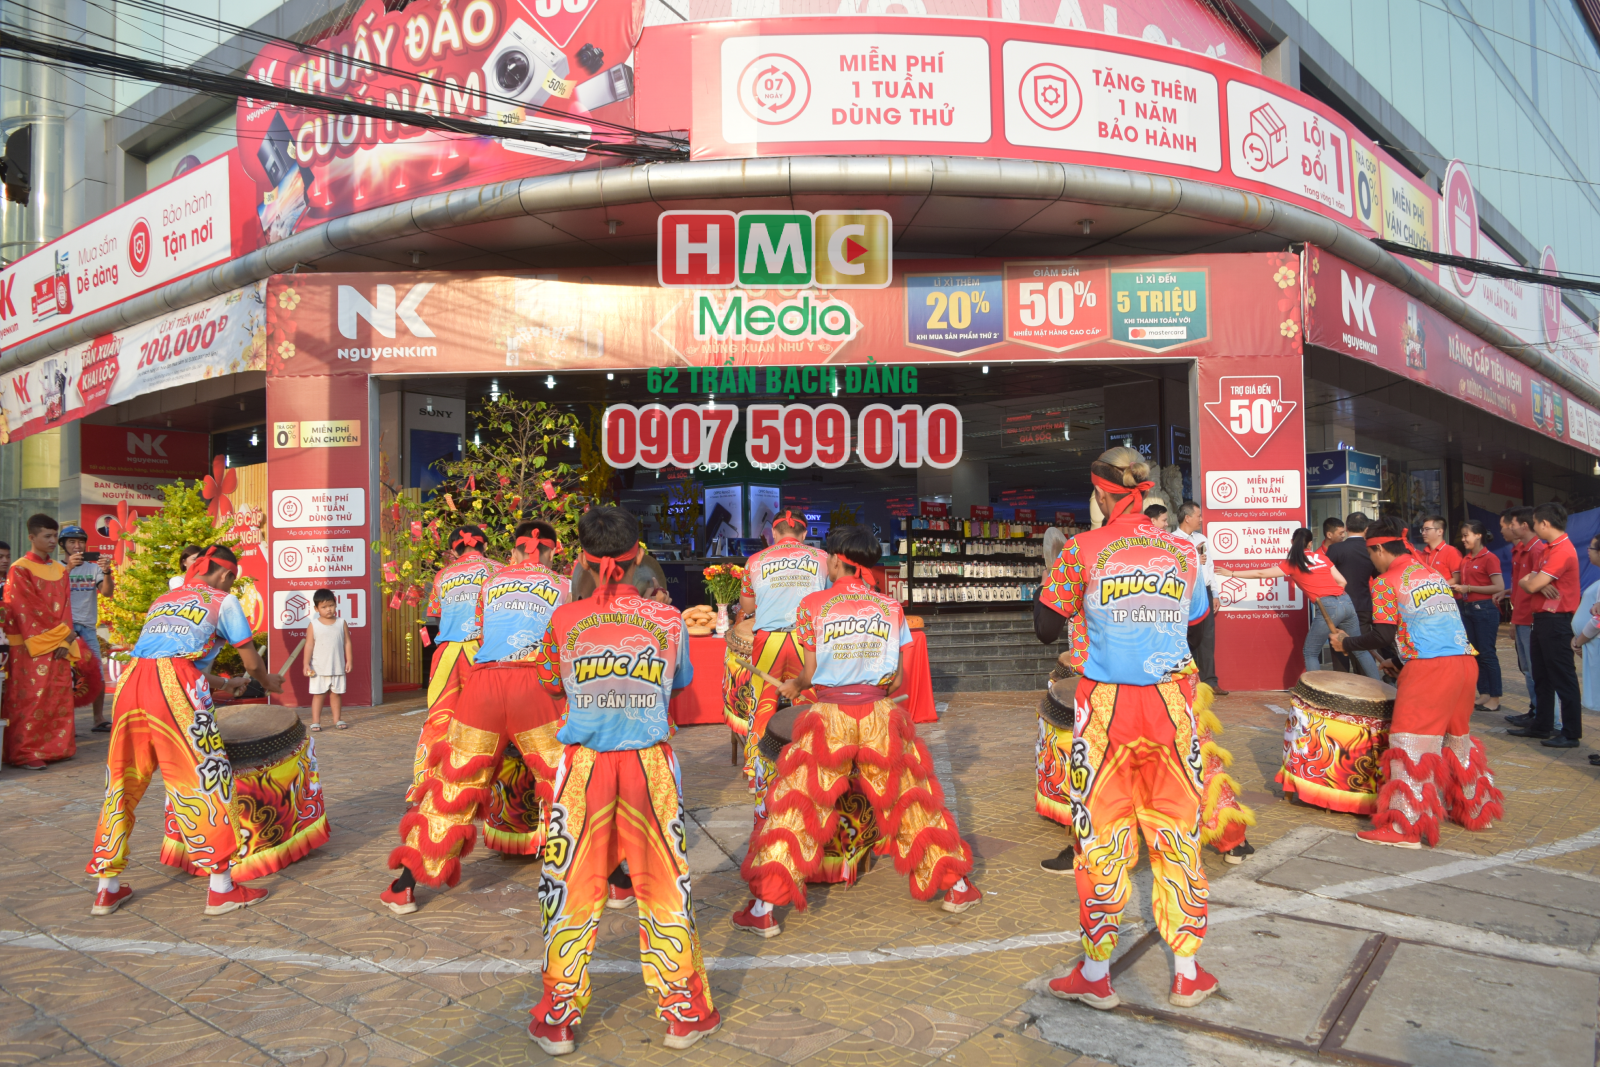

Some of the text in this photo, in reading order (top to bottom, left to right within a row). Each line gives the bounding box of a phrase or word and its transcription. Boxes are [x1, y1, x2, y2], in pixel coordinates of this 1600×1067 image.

[290, 0, 497, 107] KHUẤY ĐẢO
[839, 46, 944, 73] MIỄN PHÍ
[764, 78, 783, 91] 07
[852, 73, 934, 99] 1 TUẦN
[1092, 67, 1197, 103] TẶNG THÊM
[831, 103, 955, 127] DÙNG THỬ
[1119, 99, 1177, 124] 1 NĂM
[1098, 117, 1197, 152] BẢO HÀNH
[1303, 116, 1325, 151] LỖI
[1301, 149, 1328, 185] ĐỔI
[1330, 132, 1345, 195] 1
[1365, 159, 1376, 176] GÓP
[1304, 185, 1320, 200] Trong
[163, 190, 212, 227] Bảo hành
[1412, 204, 1424, 227] PHÍ
[1385, 209, 1401, 237] VẬN
[163, 216, 213, 261] Tận nơi
[78, 235, 118, 267] Mua sắm
[77, 264, 119, 294] Dễ dàng
[955, 277, 980, 287] THÊM
[1033, 267, 1080, 278] GIẢM ĐẾN
[1136, 273, 1177, 284] LÌ XÌ ĐẾN
[337, 282, 437, 339] NK
[926, 290, 990, 329] 20%
[1019, 280, 1097, 327] 50%
[1117, 287, 1197, 316] 5 TRIỆU
[1341, 268, 1377, 337] NK
[1160, 316, 1177, 324] TOÁN
[1178, 315, 1191, 324] VỚI
[944, 331, 958, 340] SẢN
[960, 330, 978, 339] PHẨM
[1013, 328, 1032, 337] NHIỀU
[1048, 327, 1068, 336] HÀNG
[1069, 328, 1082, 336] CAO
[1149, 328, 1185, 336] mastercard
[81, 337, 123, 367] TÂN XUÂN
[1449, 333, 1523, 393] NÂNG CẤP TIỆN NGHI
[82, 368, 99, 391] KHAI
[99, 361, 116, 385] LỘC
[1230, 383, 1271, 397] TRỢ GIÁ ĐẾN
[419, 407, 453, 418] SONY
[1230, 398, 1282, 434] 50%
[335, 424, 349, 433] PHÍ
[126, 431, 168, 457] NK
[303, 431, 358, 447] VẬN CHUYỂN
[1139, 443, 1152, 454] 8K
[94, 480, 154, 491] BAN GIÁM ĐỐC
[1258, 483, 1281, 494] TUẦN
[1270, 475, 1285, 484] PHÍ
[102, 490, 135, 500] NGUYỄN
[335, 493, 349, 502] PHÍ
[1244, 493, 1288, 503] DÙNG THỬ
[323, 502, 345, 512] TUẦN
[308, 512, 352, 522] DÙNG THỬ
[1242, 526, 1290, 537] TẶNG THÊM
[1260, 536, 1280, 544] NĂM
[306, 543, 354, 555] TẶNG THÊM
[1108, 535, 1167, 550] NGHỆ THUẬT LÂN
[1244, 545, 1289, 554] BẢO HÀNH
[308, 562, 353, 572] BẢO HÀNH
[324, 554, 344, 562] NĂM
[762, 554, 818, 580] PHÚC ẤN
[441, 573, 473, 599] PHÚC
[487, 579, 560, 607] PHÚC ẤN
[1100, 568, 1160, 606] PHÚC
[1256, 587, 1278, 601] ĐỔI
[1411, 580, 1442, 609] PHÚC
[176, 600, 208, 625] ẤN
[493, 604, 502, 612] TP
[504, 598, 526, 610] CẦN
[1112, 605, 1157, 622] TP CẦN
[1425, 606, 1436, 615] TP
[148, 622, 190, 635] CẦN THƠ
[566, 612, 669, 651] ĐOÀN NGHỆ THUẬT LÂN RỒNG
[823, 612, 891, 644] PHÚC ẤN
[630, 647, 665, 686] ẤN
[575, 690, 657, 709] TP CẦN THƠ
